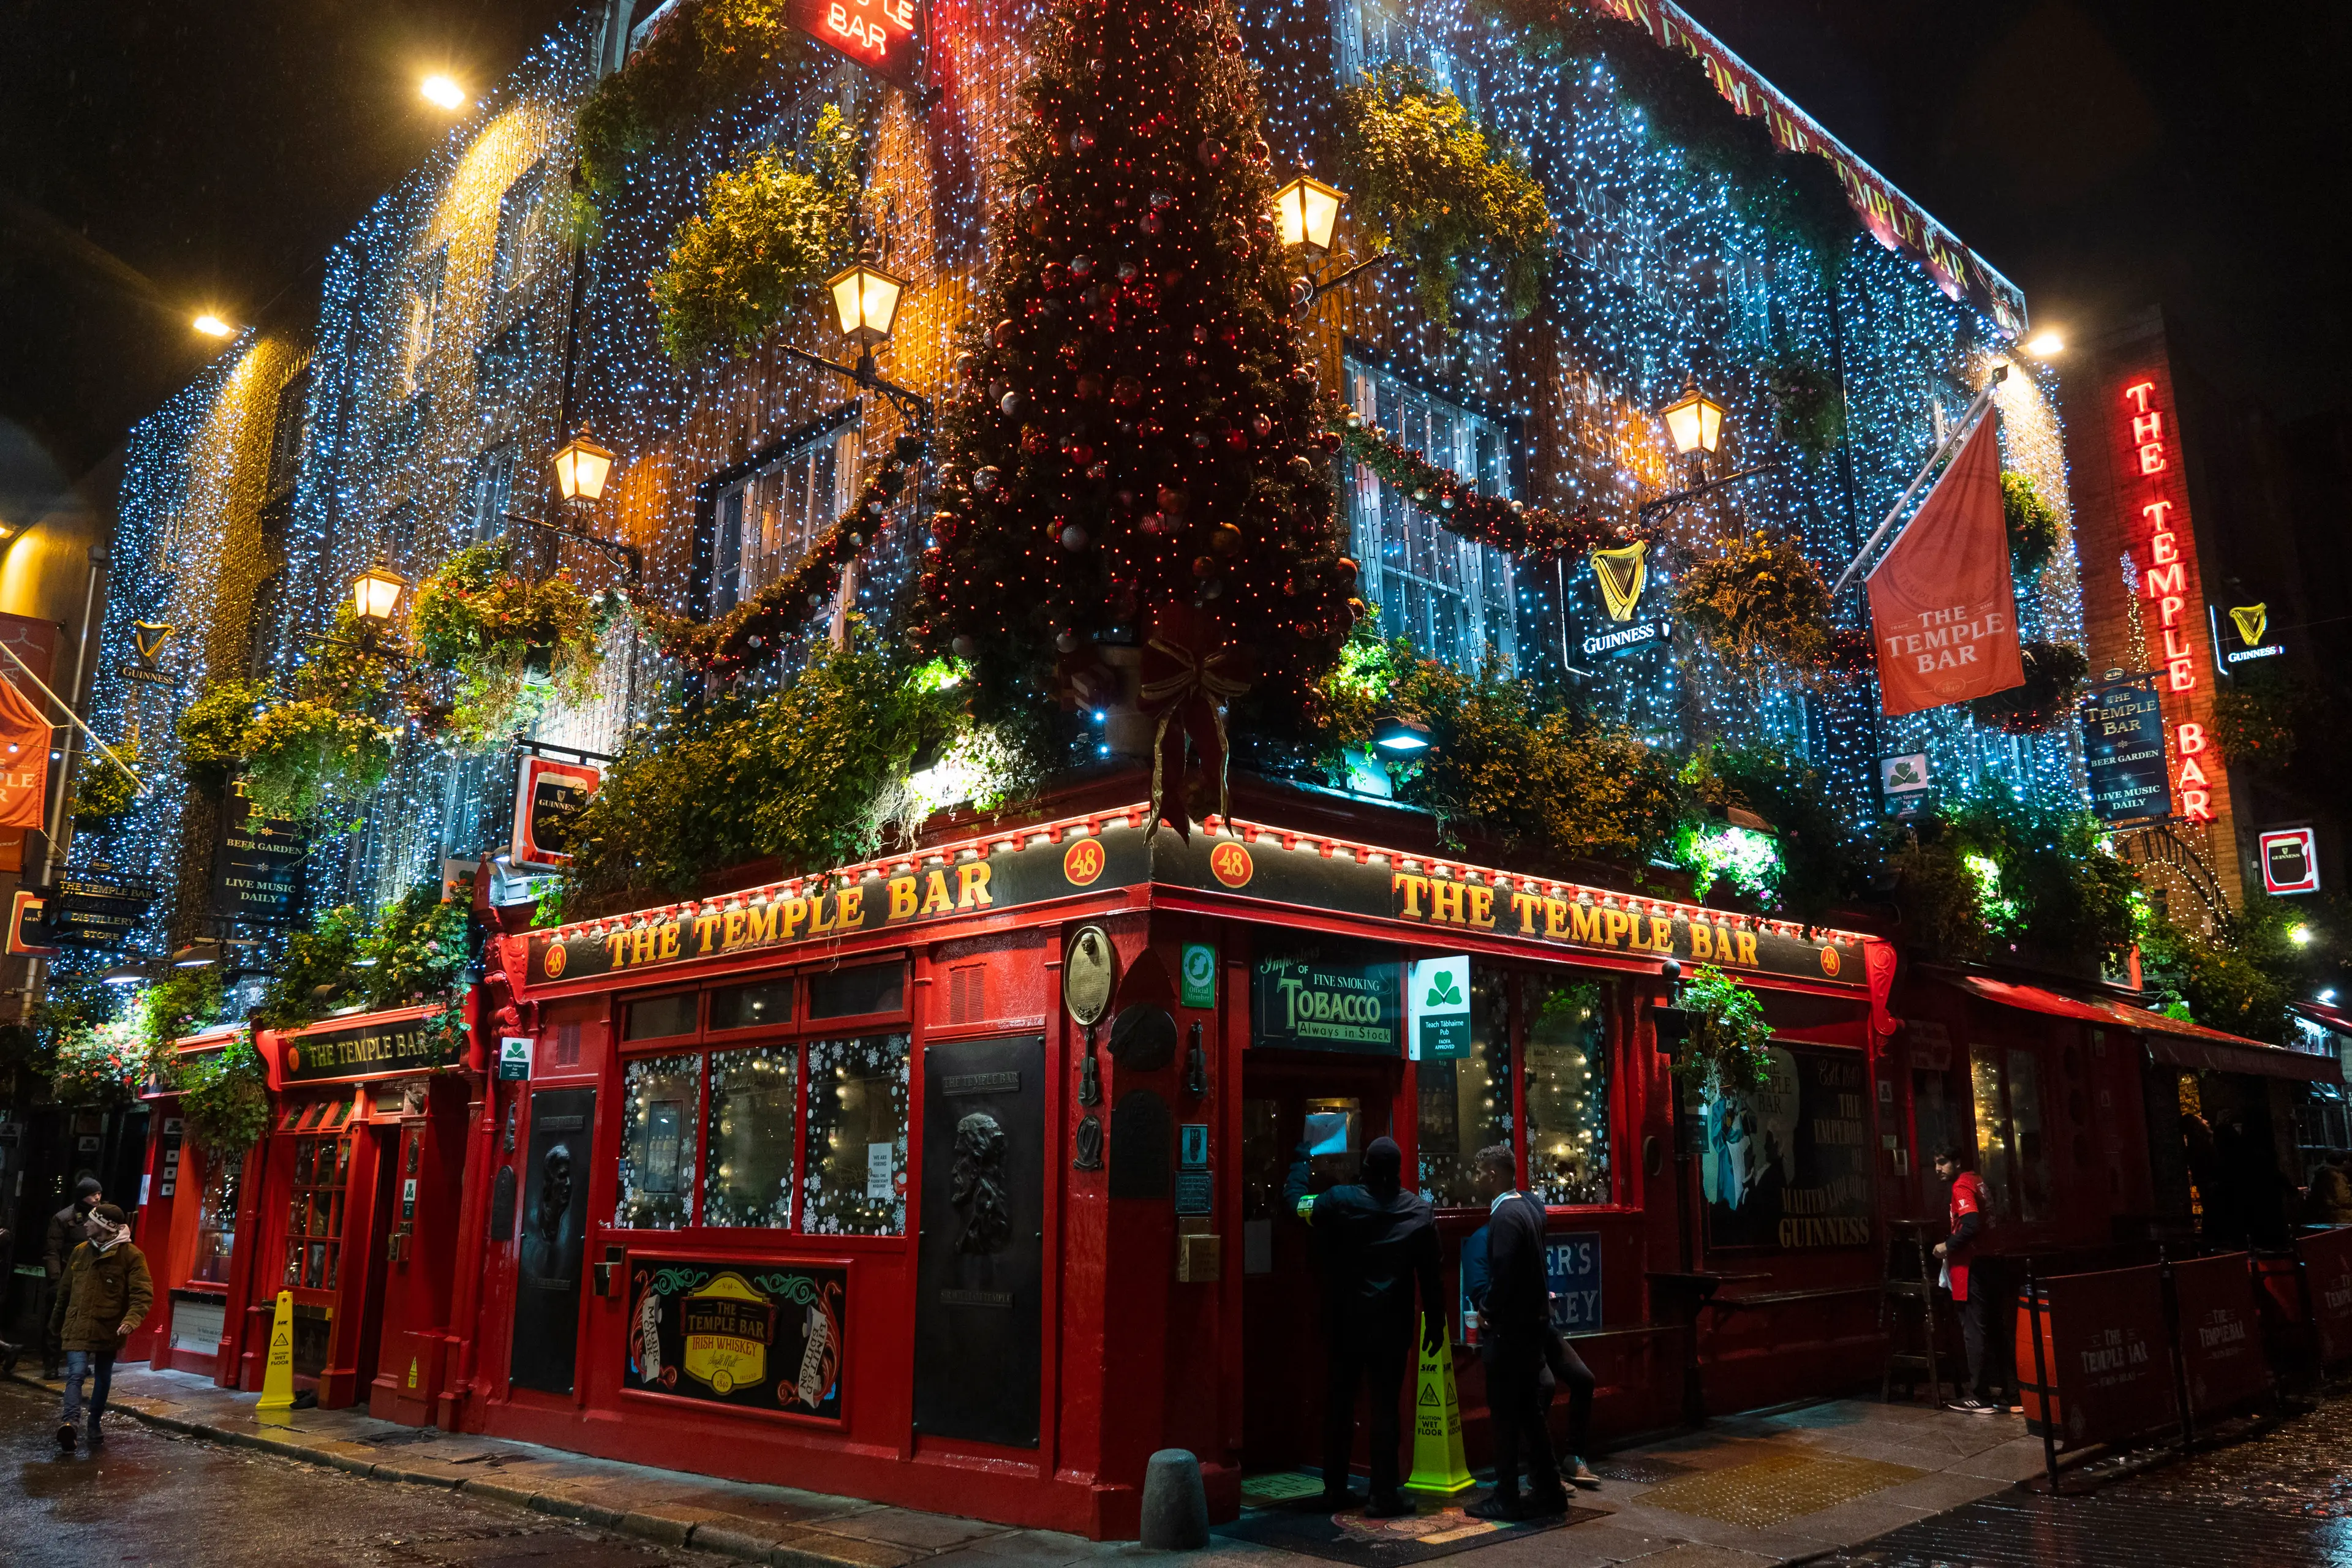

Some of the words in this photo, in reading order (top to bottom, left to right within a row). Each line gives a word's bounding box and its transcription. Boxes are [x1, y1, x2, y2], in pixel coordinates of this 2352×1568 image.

[827, 2, 886, 55] BAR
[1757, 94, 1809, 154] THE
[1921, 228, 1970, 292] BAR
[2126, 382, 2166, 477] THE
[1607, 595, 1618, 609] 1759
[1980, 602, 1995, 611] MARK
[2143, 500, 2198, 693] TEMPLE
[1918, 606, 1967, 628] THE
[1583, 623, 1655, 654] GUINNESS
[1885, 612, 2005, 658] TEMPLE
[1917, 644, 1978, 674] BAR
[2229, 646, 2277, 663] GUINNESS
[123, 666, 175, 685] GUINNESS
[2107, 692, 2131, 704] THE
[2084, 700, 2157, 723] TEMPLE
[2102, 719, 2142, 736] BAR
[2090, 756, 2117, 768] BEER
[2118, 749, 2159, 763] GARDEN
[2176, 723, 2216, 822] BAR
[2097, 791, 2124, 802] LIVE
[2124, 785, 2161, 798] MUSIC
[2112, 798, 2146, 810] DAILY
[539, 799, 576, 811] GUINNES
[227, 838, 256, 850] BEER
[258, 842, 303, 855] GARDEN
[60, 881, 82, 891] THE
[85, 883, 128, 896] TEMPLE
[130, 888, 153, 899] BAR
[225, 878, 254, 888] LIVE
[257, 881, 296, 893] MUSIC
[240, 892, 279, 903] DAILY
[548, 952, 563, 971] 48
[607, 922, 681, 968] THE
[693, 885, 864, 954] TEMPLE
[888, 861, 993, 921] BAR
[1070, 845, 1097, 881] 48
[70, 912, 137, 927] DISTILLERY
[1218, 848, 1245, 878] 48
[1394, 872, 1496, 929] THE
[1511, 891, 1674, 954] TEMPLE
[1689, 922, 1758, 967] BAR
[1823, 951, 1838, 973] 48
[83, 930, 120, 940] STORE
[1298, 965, 1309, 974] OF
[1313, 973, 1336, 987] FINE
[1337, 976, 1380, 991] SMOKING
[1187, 992, 1210, 1001] Member
[1277, 978, 1381, 1030] TOBACCO
[1299, 1022, 1339, 1038] Always
[1344, 1027, 1355, 1038] in
[1359, 1026, 1390, 1041] Stock
[309, 1043, 335, 1068] THE
[337, 1036, 393, 1065] TEMPLE
[395, 1030, 428, 1058] BAR
[943, 1078, 960, 1088] THE
[999, 1072, 1019, 1084] BAR
[1757, 1094, 1782, 1115] BAR
[1838, 1094, 1862, 1118] THE
[1814, 1118, 1863, 1144] EMPEROR
[1781, 1187, 1825, 1215] MALTED
[1779, 1216, 1869, 1248] GUINNESS
[717, 1302, 737, 1316] THE
[648, 1305, 659, 1366] MALBEC
[688, 1315, 735, 1332] TEMPLE
[739, 1319, 765, 1338] BAR
[2103, 1328, 2122, 1346] THE
[644, 1320, 652, 1358] CASK
[693, 1336, 714, 1350] IRISH
[717, 1338, 758, 1357] WHISKEY
[799, 1327, 819, 1390] EDITION
[806, 1322, 826, 1395] LIMITED
[2081, 1347, 2125, 1373] TEMPLE
[717, 1379, 729, 1389] 1840
[1417, 1428, 1442, 1436] FLOOR
